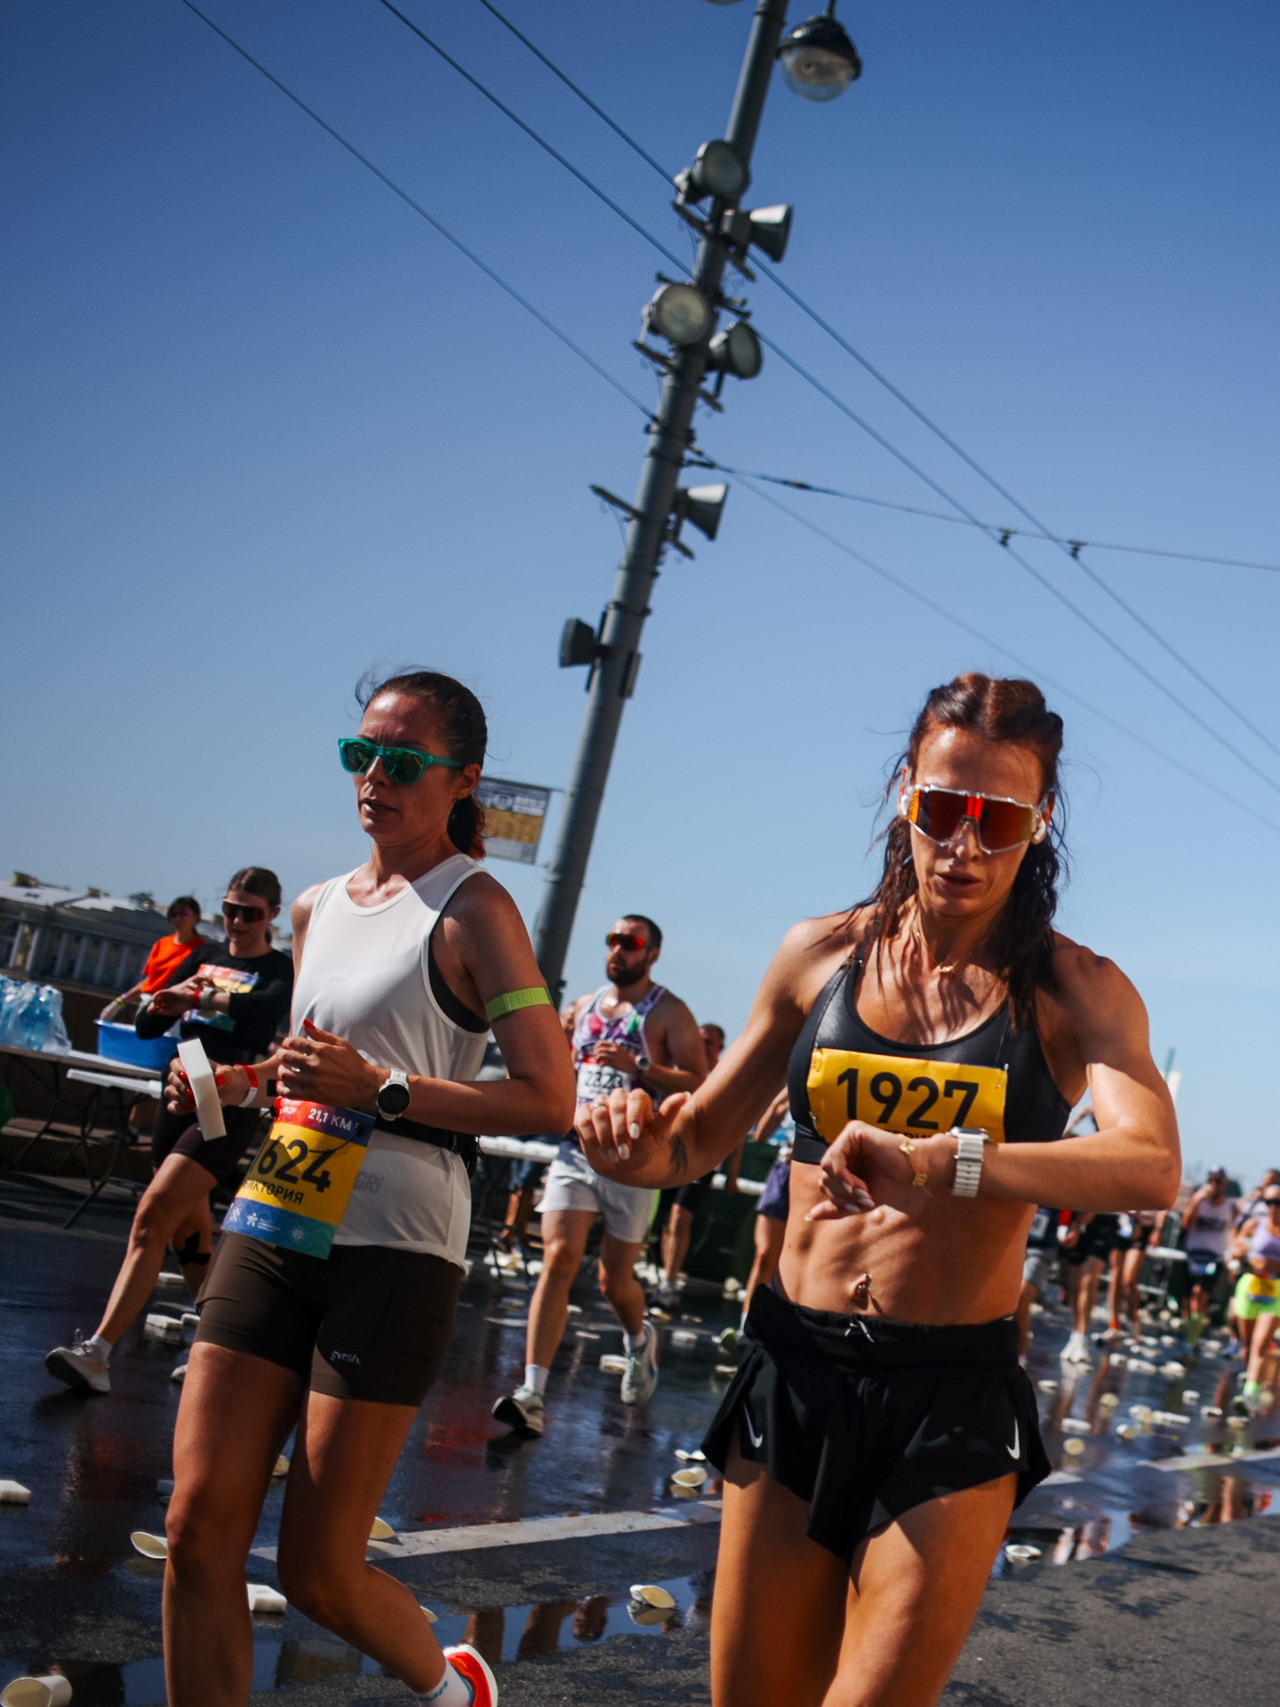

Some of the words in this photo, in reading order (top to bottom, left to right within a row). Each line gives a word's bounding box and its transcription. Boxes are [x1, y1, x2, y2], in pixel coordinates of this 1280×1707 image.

[307, 1107, 329, 1124] 21,1
[836, 1067, 979, 1130] 1927
[249, 1134, 332, 1193] 624
